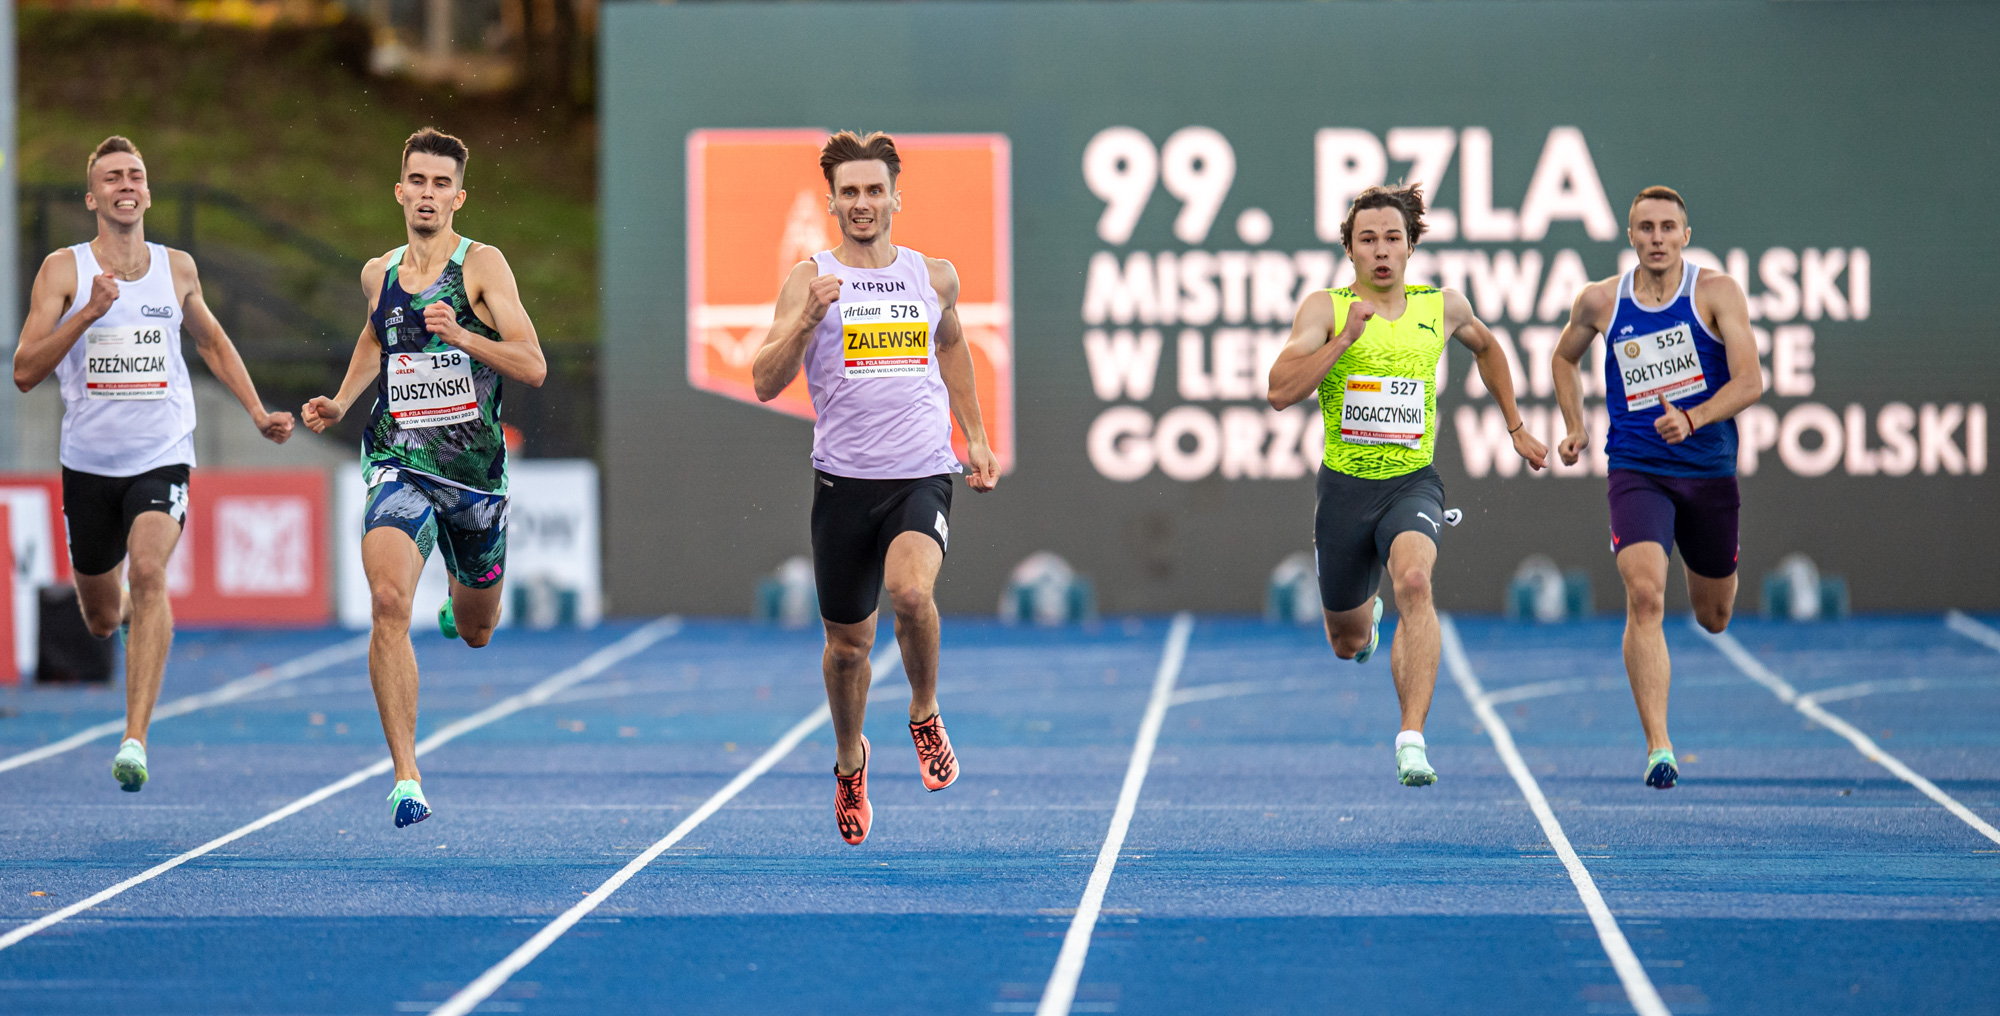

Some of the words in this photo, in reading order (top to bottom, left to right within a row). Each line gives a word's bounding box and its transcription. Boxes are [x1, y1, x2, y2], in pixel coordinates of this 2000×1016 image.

[1082, 126, 1273, 245] 99.
[1314, 127, 1619, 242] PZLA
[852, 281, 905, 292] KIPRUN
[844, 306, 881, 318] Artisan
[890, 305, 919, 318] 578
[133, 330, 161, 344] 168
[847, 331, 926, 350] ZALEWSKI
[1656, 330, 1685, 349] 552
[89, 354, 166, 373] RZEŹNICZAK
[430, 353, 461, 369] 158
[1082, 329, 1163, 400] W
[1625, 353, 1696, 386] SOŁTYSIAK
[391, 377, 471, 402] DUSZYŃSKI
[1390, 381, 1417, 395] 527
[420, 414, 460, 423] WIELKOPOLSKI
[1344, 404, 1422, 424] BOGACZYŃSKI
